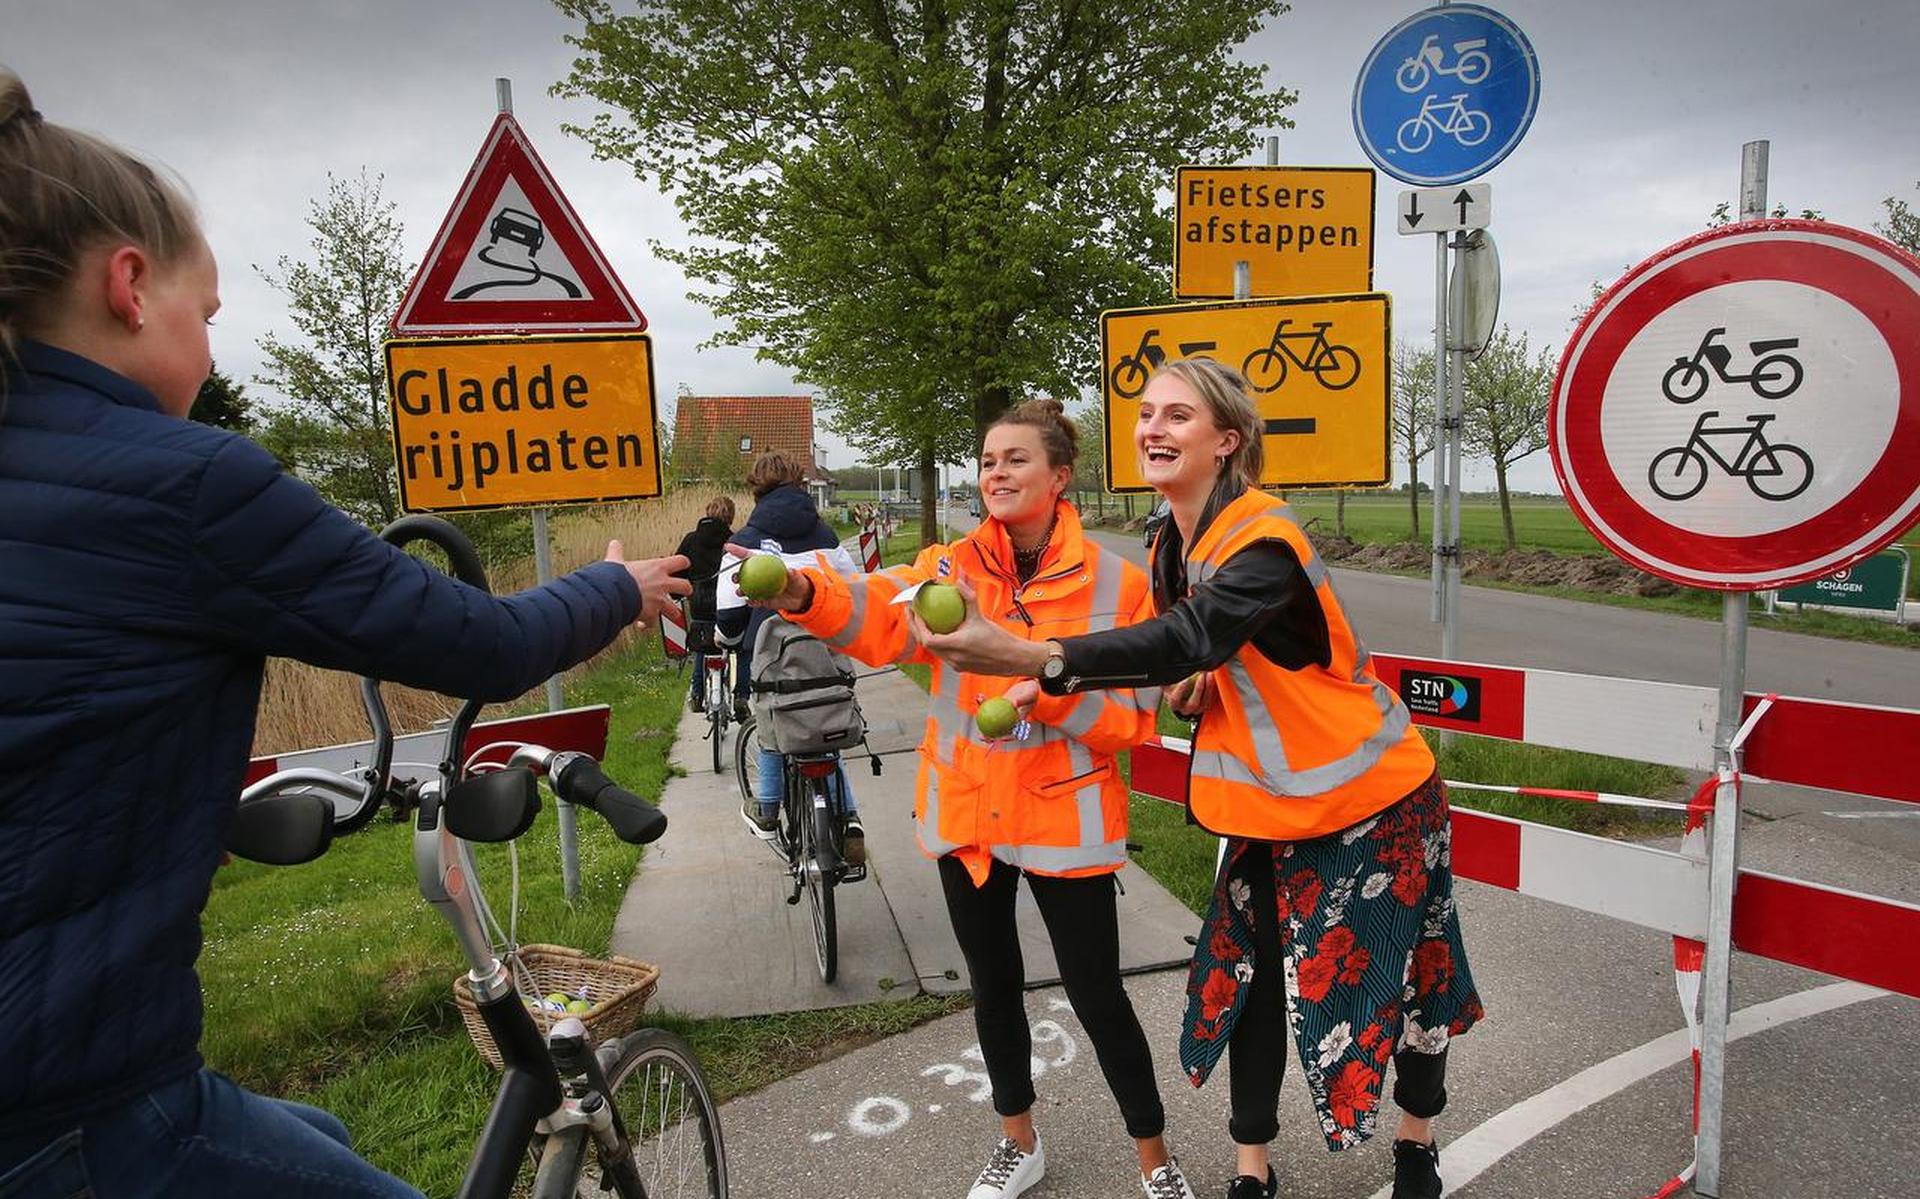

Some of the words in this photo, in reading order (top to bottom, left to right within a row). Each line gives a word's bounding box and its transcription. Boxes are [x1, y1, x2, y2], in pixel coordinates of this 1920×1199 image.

[1188, 179, 1326, 209] Fietsers
[1186, 216, 1358, 252] afstappen
[397, 364, 589, 415] Gladde
[405, 429, 643, 491] rijplaten
[1816, 580, 1863, 592] SCHAGEN
[1411, 679, 1444, 697] STN
